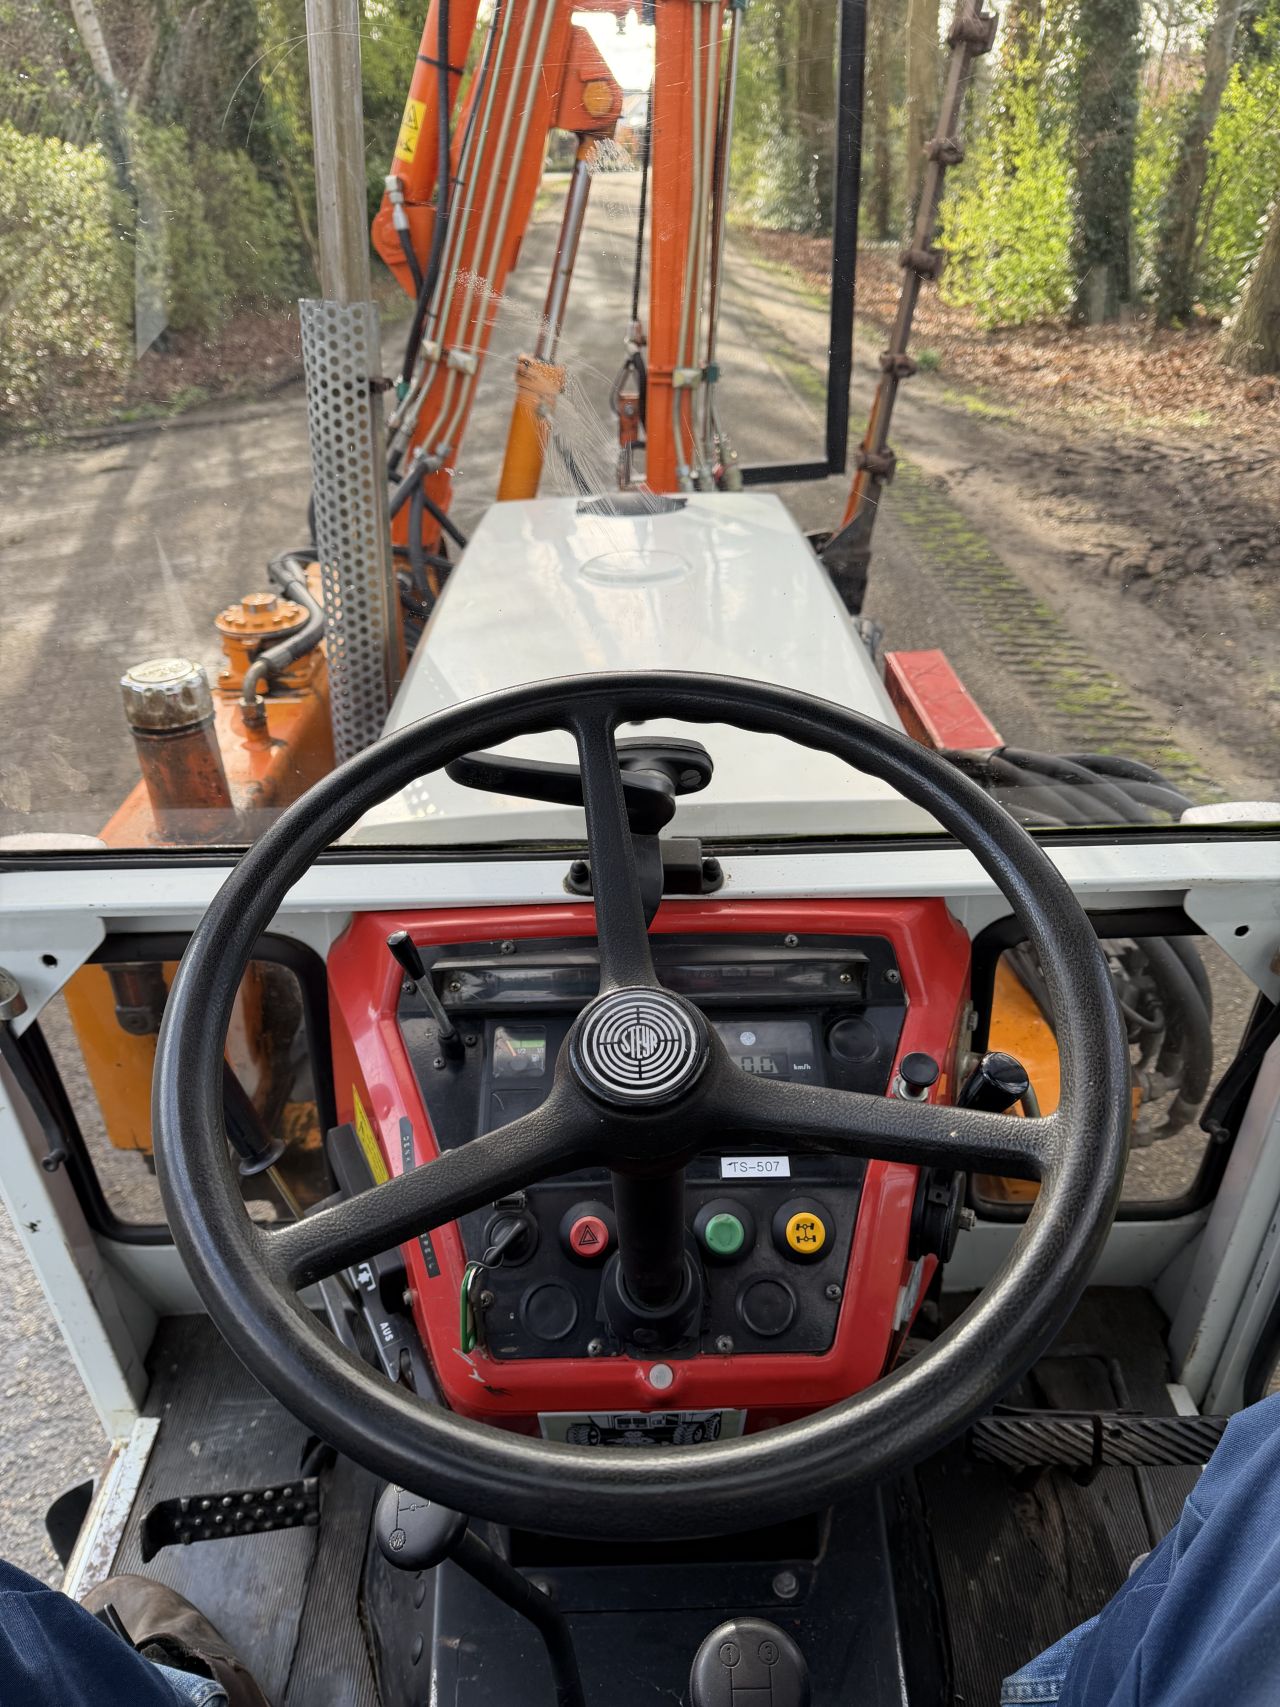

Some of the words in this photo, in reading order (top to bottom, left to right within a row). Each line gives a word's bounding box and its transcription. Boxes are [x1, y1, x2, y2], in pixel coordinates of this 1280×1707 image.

[620, 1025, 658, 1059] STEYR
[730, 1161, 780, 1172] TS-507
[379, 1321, 394, 1342] AUS
